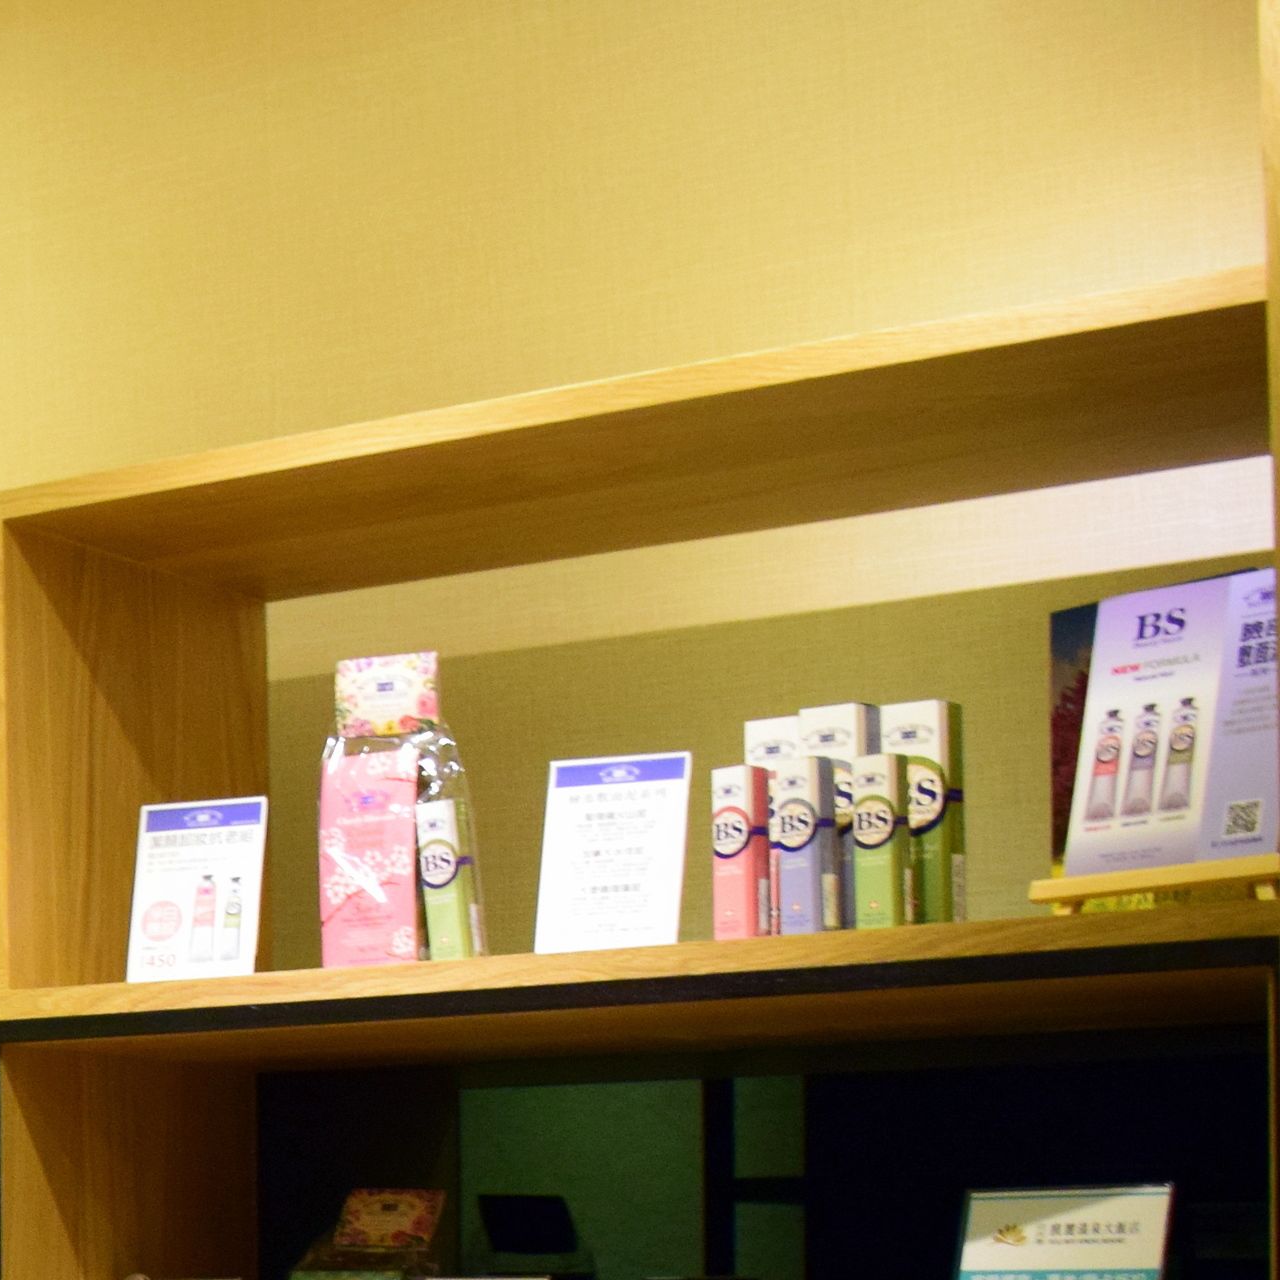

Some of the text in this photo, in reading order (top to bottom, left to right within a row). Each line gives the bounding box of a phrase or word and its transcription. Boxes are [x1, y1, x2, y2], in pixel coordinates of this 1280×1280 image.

[1136, 607, 1186, 641] BS
[715, 820, 744, 841] BS
[780, 812, 810, 835] BS
[856, 809, 889, 832] BS
[423, 852, 452, 873] BS
